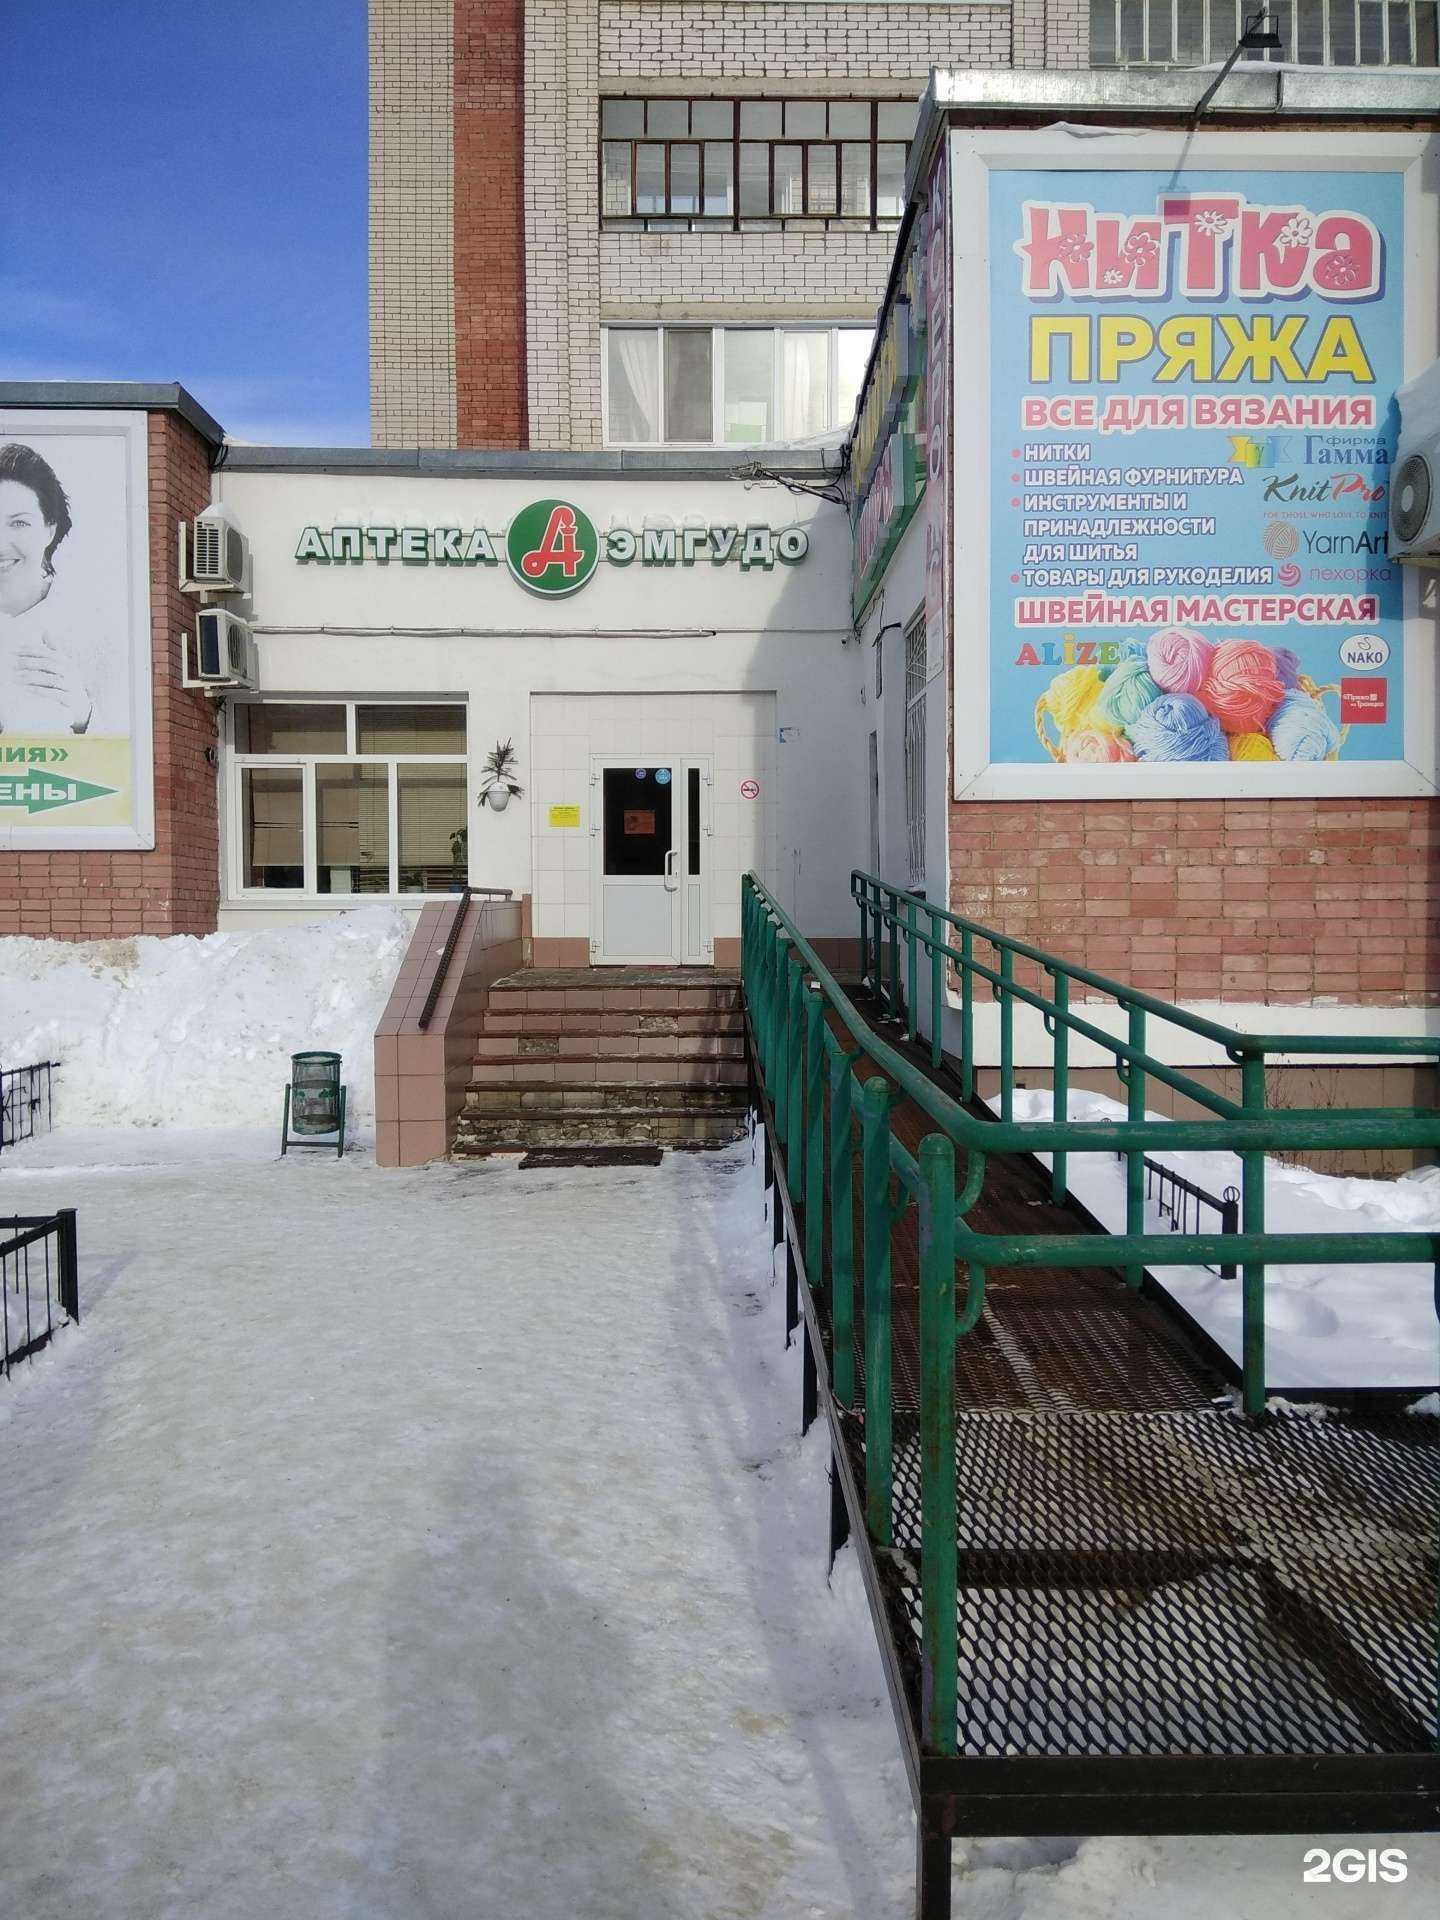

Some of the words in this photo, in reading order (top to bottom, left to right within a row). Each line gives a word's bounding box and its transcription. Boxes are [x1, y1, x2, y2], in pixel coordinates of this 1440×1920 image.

[1029, 314, 1376, 384] ПРЯЖА
[1024, 399, 1094, 427] ВСЕ
[1101, 398, 1185, 431] ДЛЯ
[1194, 398, 1373, 427] ВЯЗАНИЯ
[1303, 435, 1389, 465] Гамма
[1326, 436, 1386, 446] фирма
[1024, 443, 1091, 462] НИТКИ
[1024, 464, 1121, 486] ШВЕЙНАЯ
[1124, 466, 1244, 486] ФУРНИТУРА
[1024, 493, 1172, 511] ИНСТРУМЕНТЫ
[1173, 493, 1188, 510] И
[1023, 518, 1216, 539] ПРИНАДЛЕЖНОСТИ
[295, 526, 499, 562] АПТЕКА
[607, 527, 810, 566] ЭМГУДО
[1302, 530, 1389, 555] YarnArt
[1023, 544, 1065, 565] ДЛЯ
[1068, 543, 1138, 561] ШИТЬЯ
[1023, 569, 1105, 587] ТОВАРЫ
[1107, 567, 1150, 588] ДЛЯ
[1153, 566, 1273, 587] РУКОДЕЛИЯ
[1308, 567, 1392, 584] пехорка
[1017, 593, 1169, 624] ШВЕЙНАЯ
[1175, 597, 1377, 623] МАСТЕРСКАЯ
[1347, 651, 1383, 664] NAKO
[0, 747, 69, 762] ИЯ»
